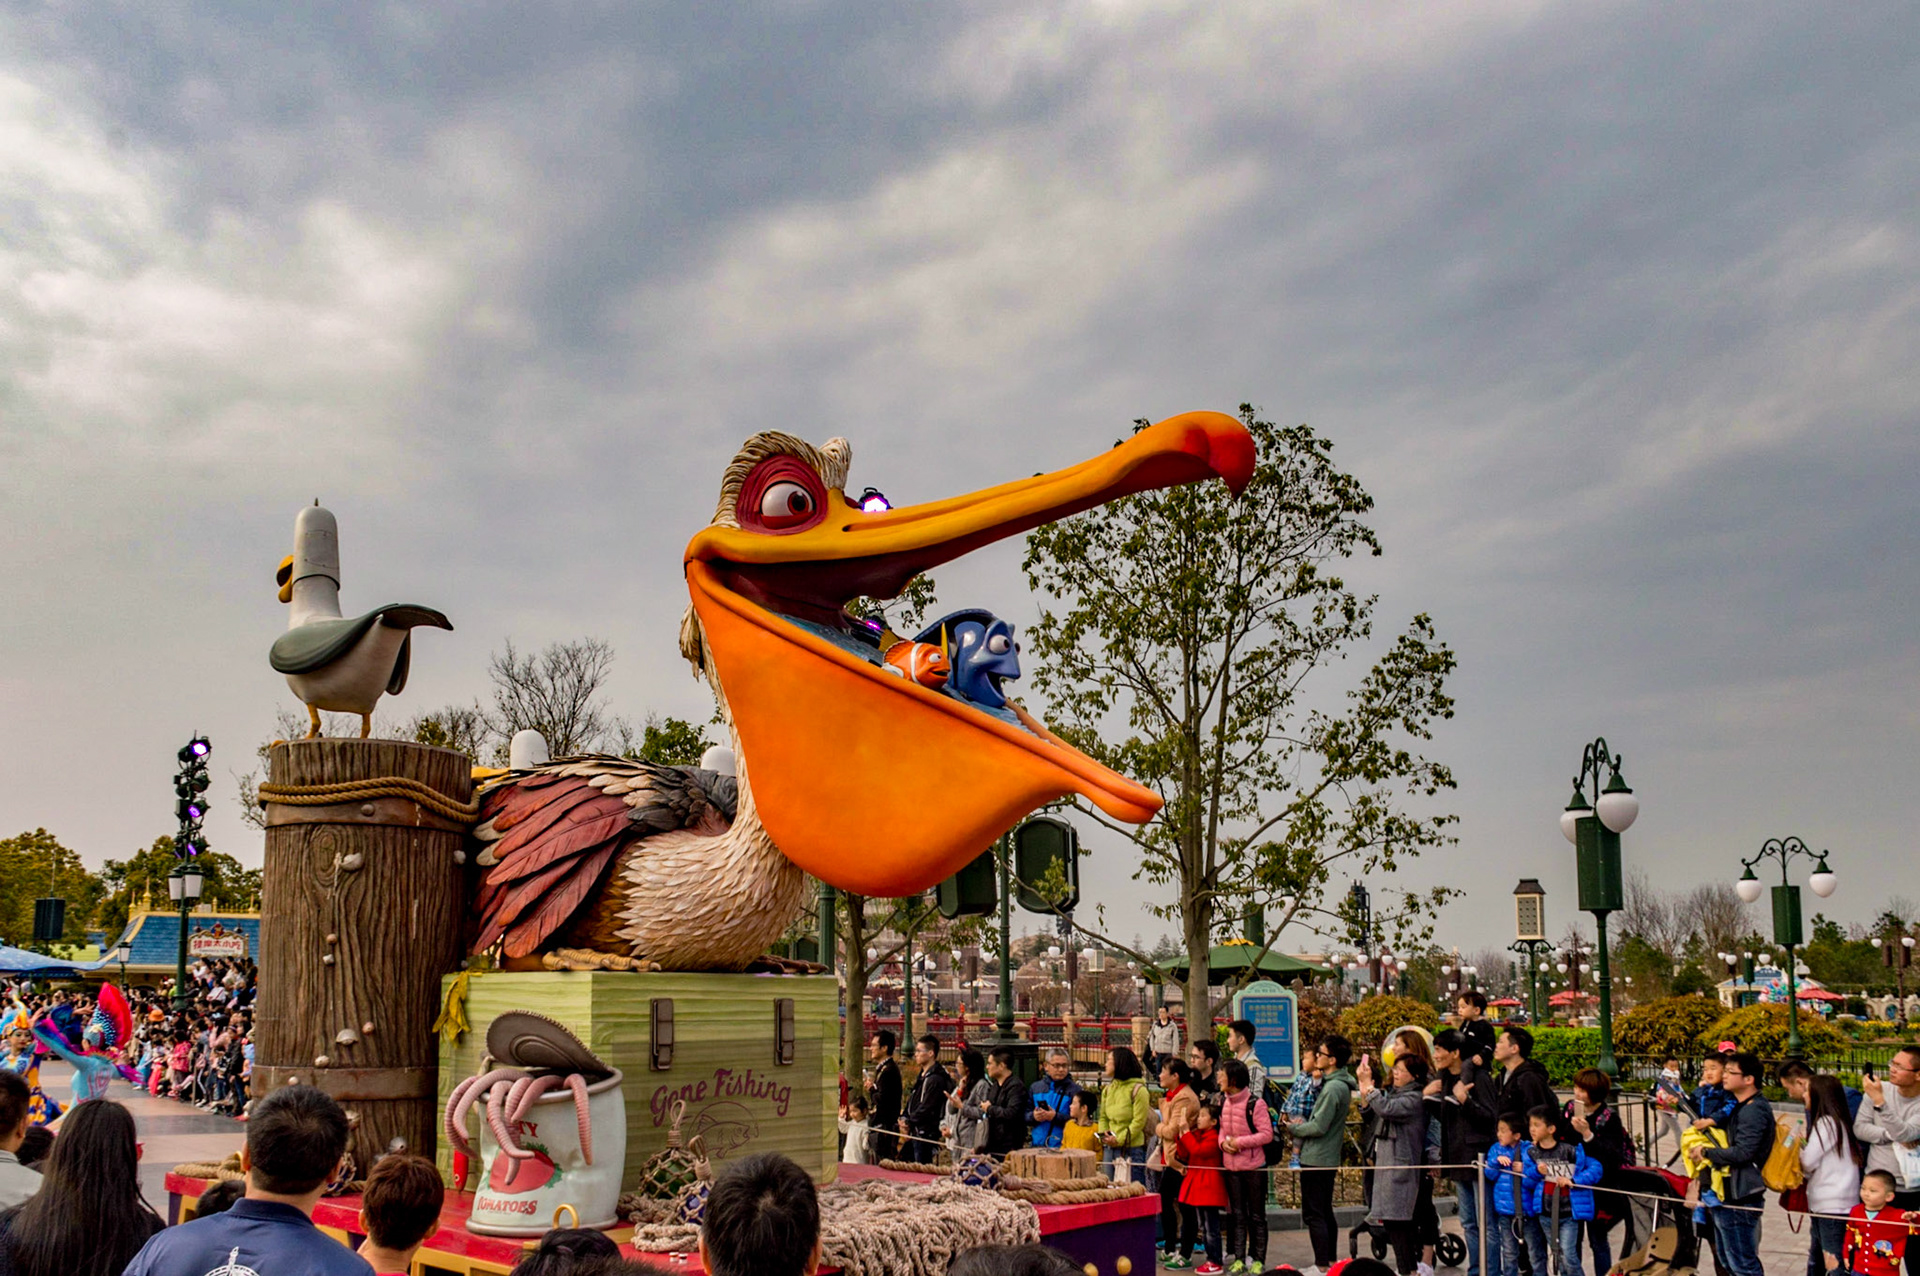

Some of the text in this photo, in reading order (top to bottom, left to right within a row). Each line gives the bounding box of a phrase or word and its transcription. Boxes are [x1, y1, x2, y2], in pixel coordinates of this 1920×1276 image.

[650, 1068, 792, 1128] Gone Fishing
[477, 1196, 538, 1216] TOMATOES
